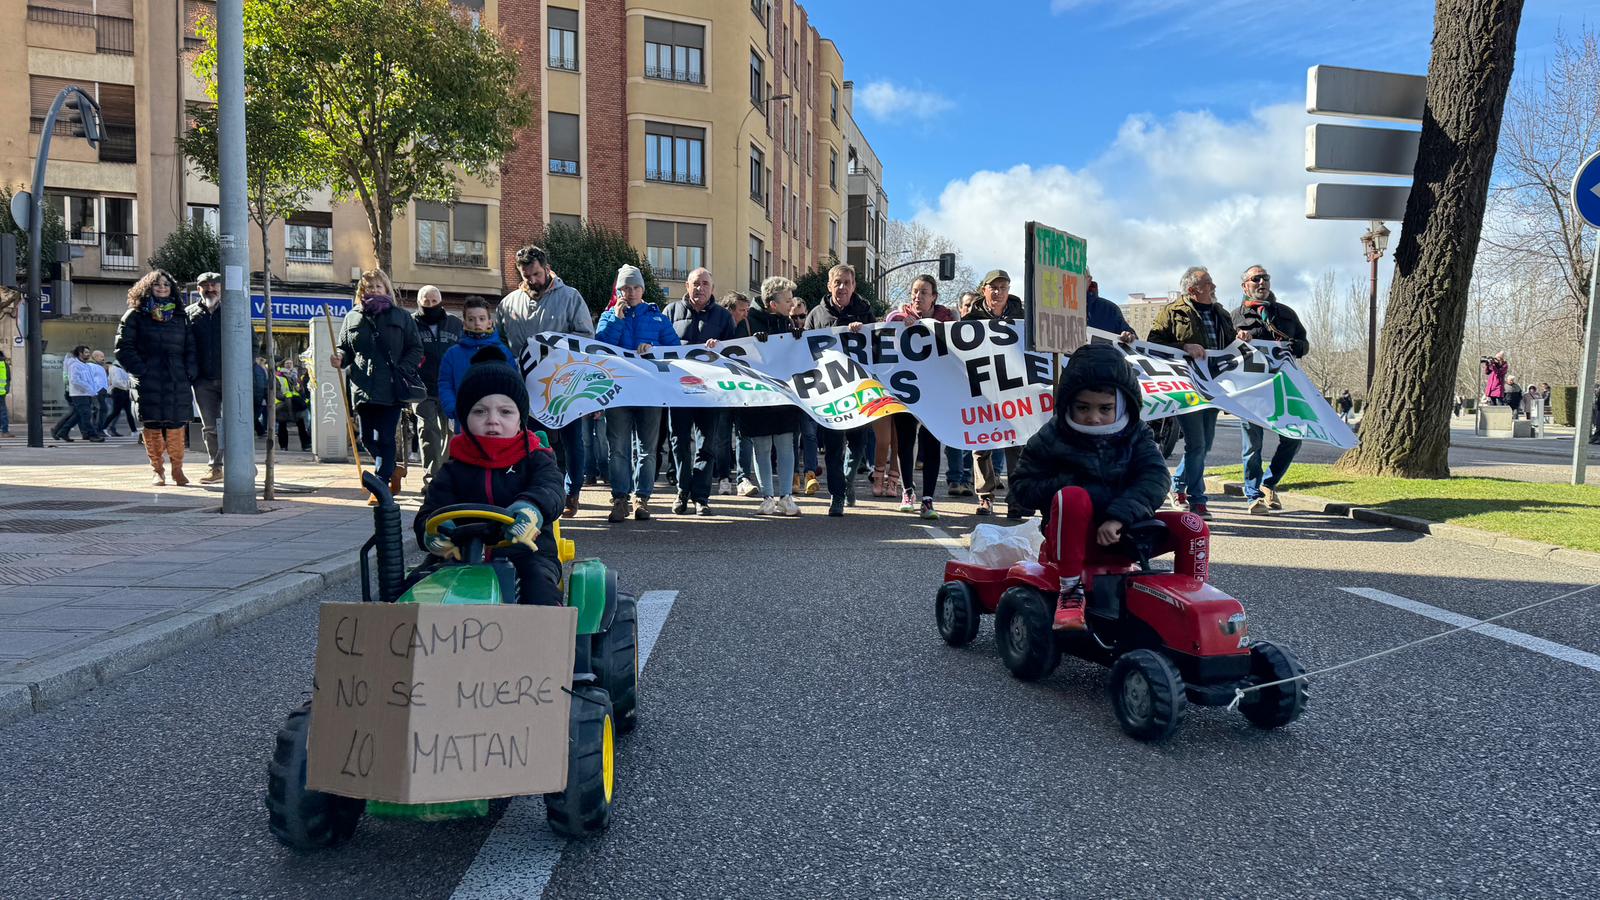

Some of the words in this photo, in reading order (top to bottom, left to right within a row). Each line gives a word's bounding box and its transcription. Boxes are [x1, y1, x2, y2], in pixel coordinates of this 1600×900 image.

[1043, 271, 1059, 309] ES
[1063, 273, 1079, 311] MI
[807, 318, 1019, 366] PRECIOS
[1039, 312, 1087, 350] FUTURO
[596, 383, 623, 407] UPA
[961, 397, 1033, 426] UNION
[1039, 392, 1054, 413] D
[964, 427, 1017, 445] León
[335, 616, 364, 656] EL
[389, 617, 504, 659] CAMPO
[336, 675, 368, 707] NO
[386, 681, 427, 707] SE
[457, 675, 554, 709] MUERE
[340, 729, 375, 778] LO
[413, 726, 529, 775] MATAN
